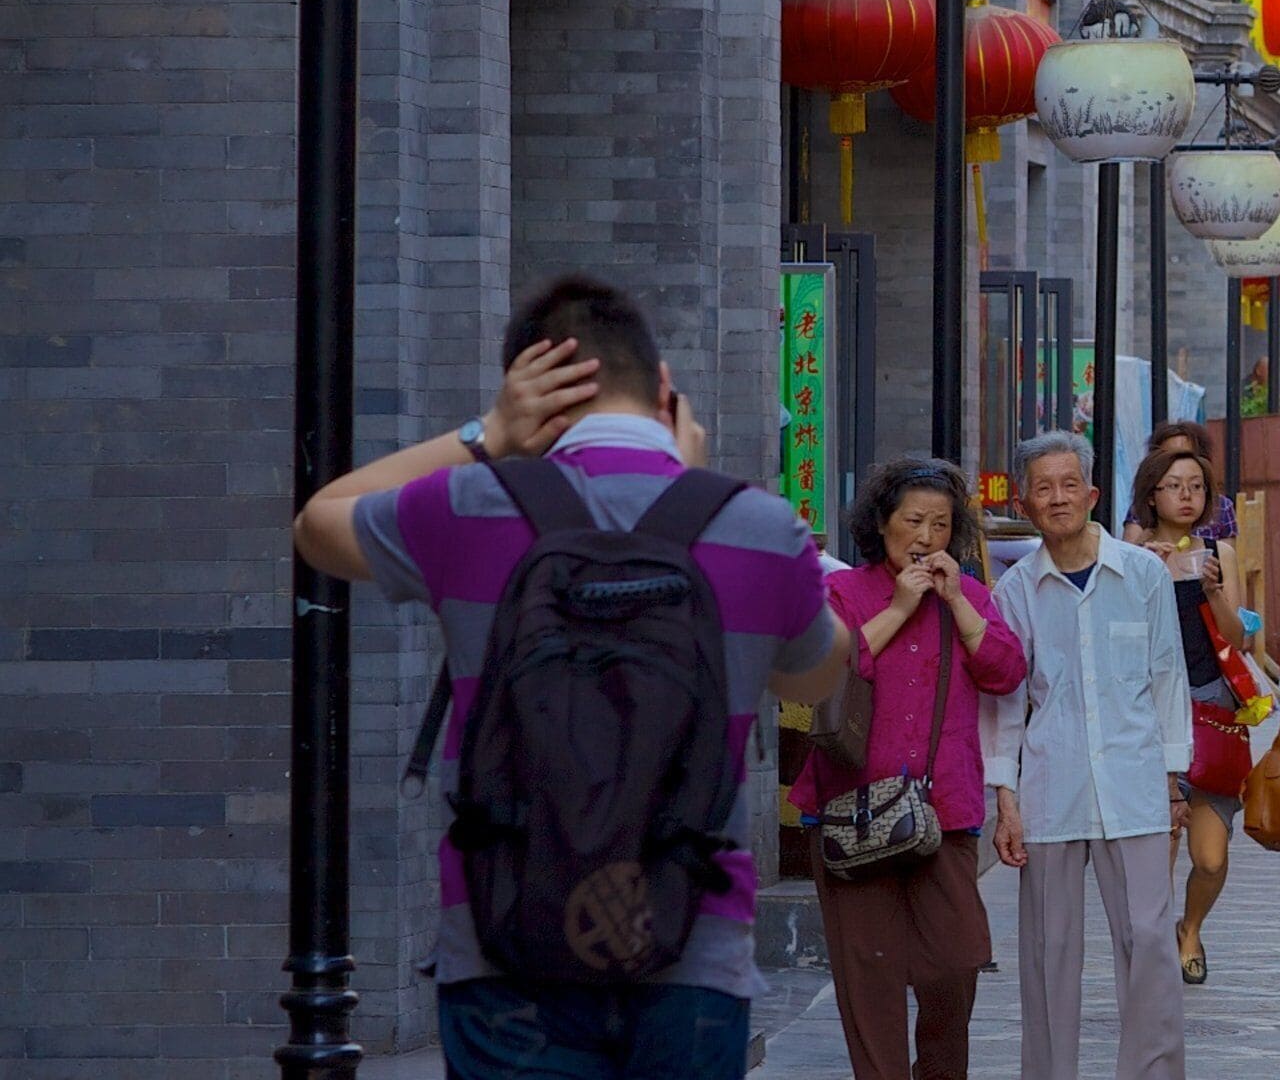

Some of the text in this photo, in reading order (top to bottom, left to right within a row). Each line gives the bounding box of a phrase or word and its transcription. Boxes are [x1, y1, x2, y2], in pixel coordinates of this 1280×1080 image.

[792, 311, 819, 528] 老北京炸酱面
[978, 474, 1009, 503] 临
